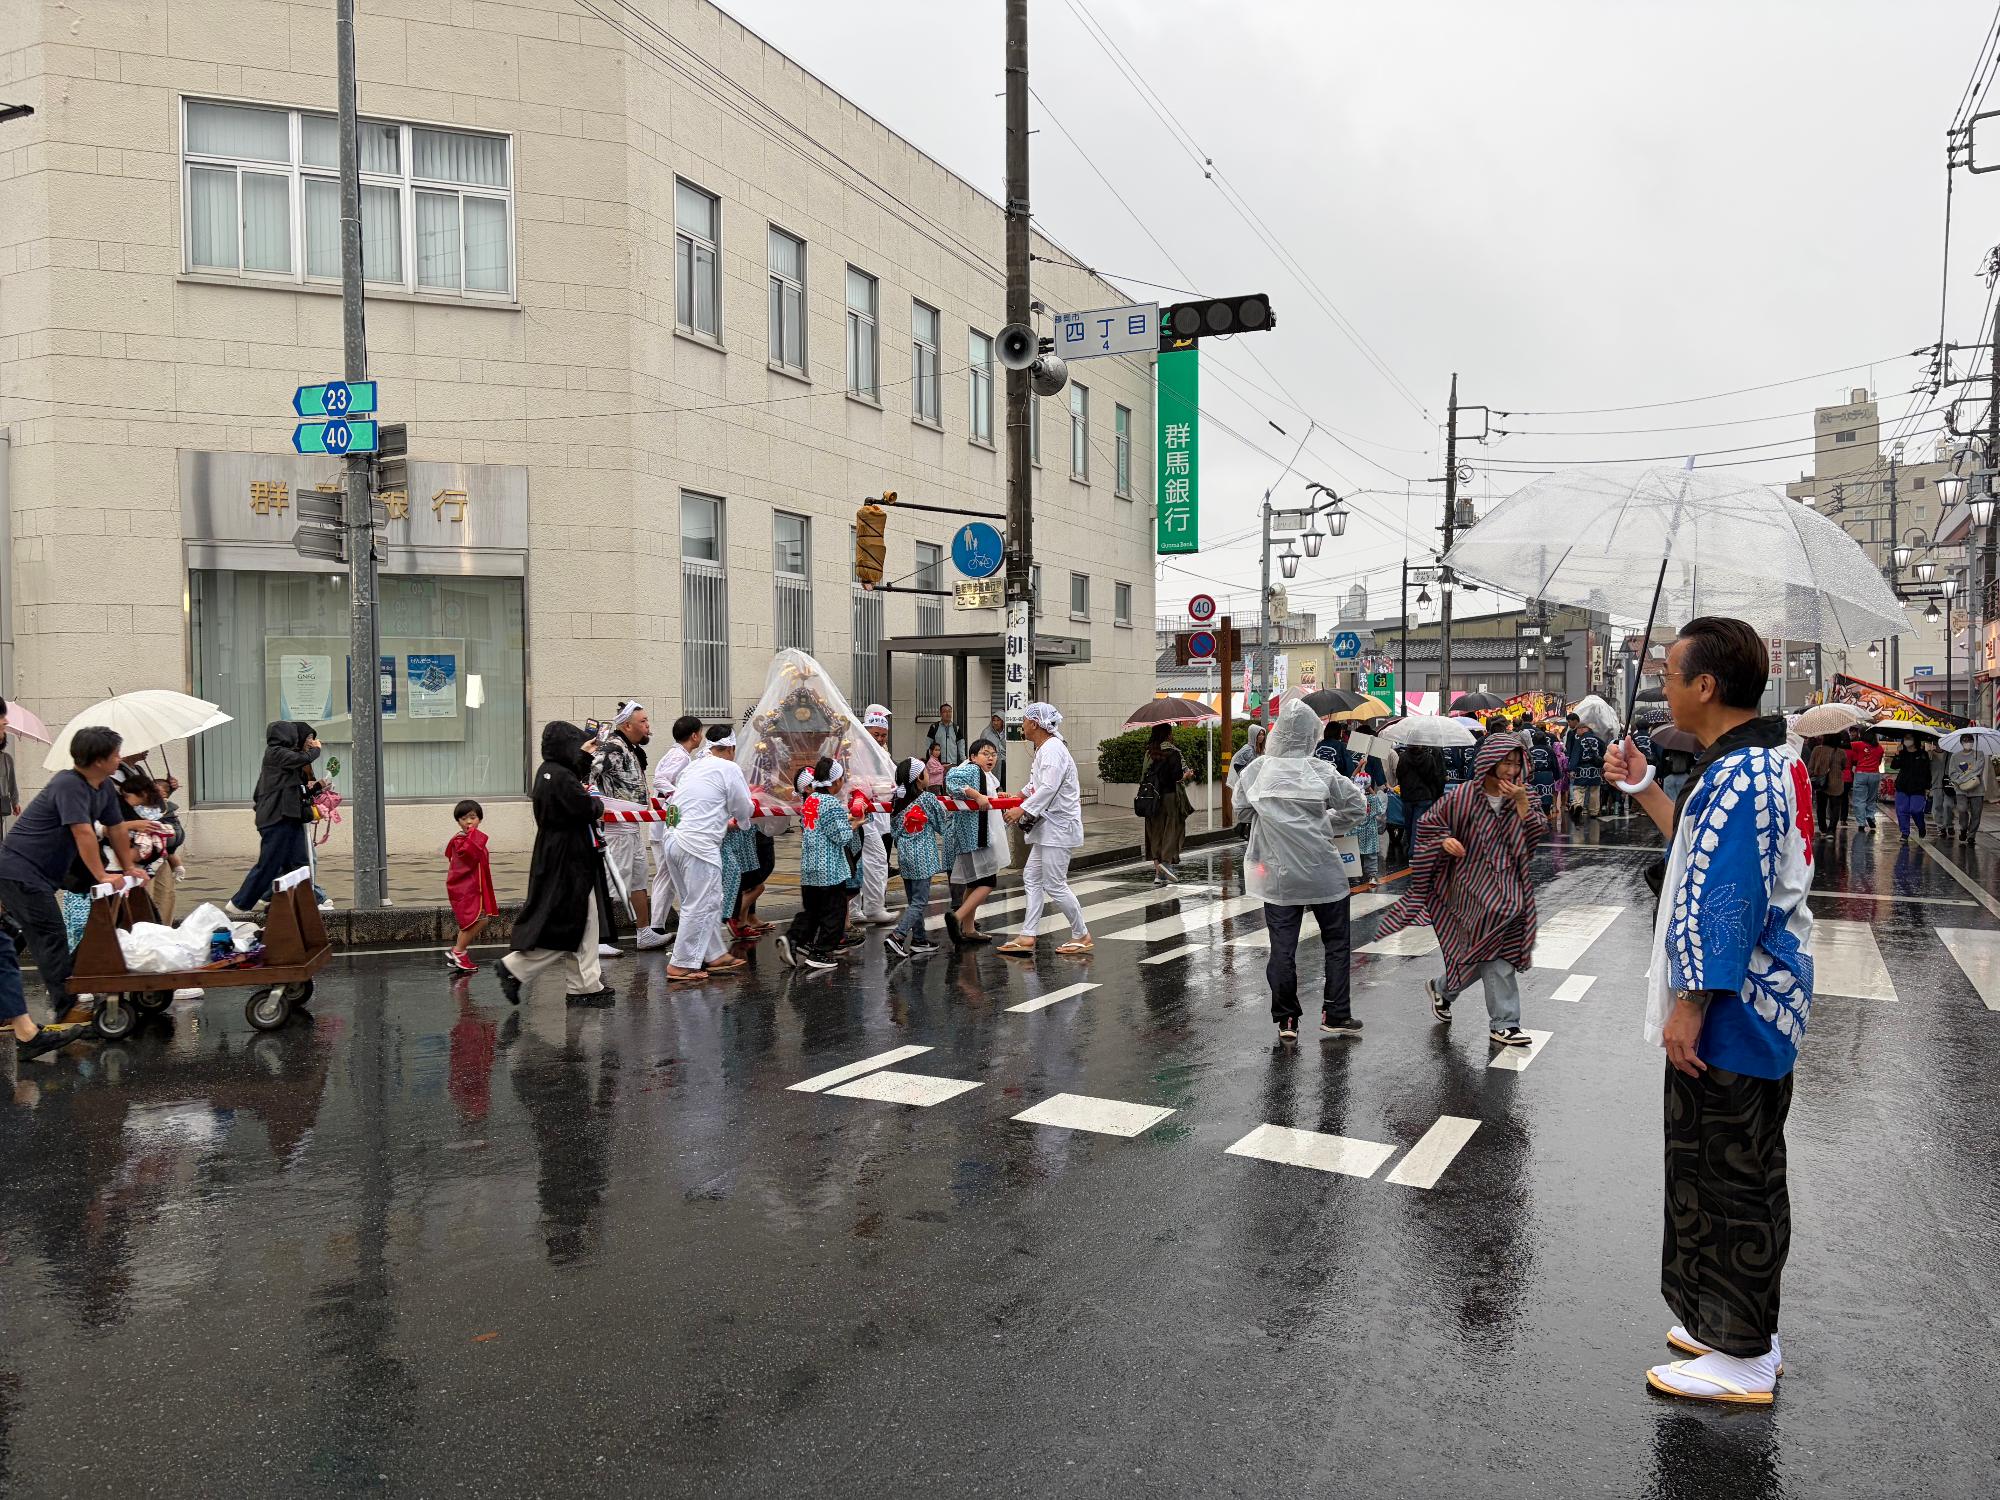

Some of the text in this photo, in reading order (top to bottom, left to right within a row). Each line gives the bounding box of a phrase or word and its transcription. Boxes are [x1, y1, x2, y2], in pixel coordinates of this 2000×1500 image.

[1066, 314, 1146, 343] 四丁目
[1102, 340, 1110, 350] 4
[327, 388, 347, 410] 23
[326, 426, 348, 448] 40
[1164, 422, 1191, 533] 群馬銀行
[250, 480, 469, 522] 群銀行
[957, 594, 999, 606] ここまで
[1194, 602, 1210, 614] 40
[1339, 639, 1355, 650] 40
